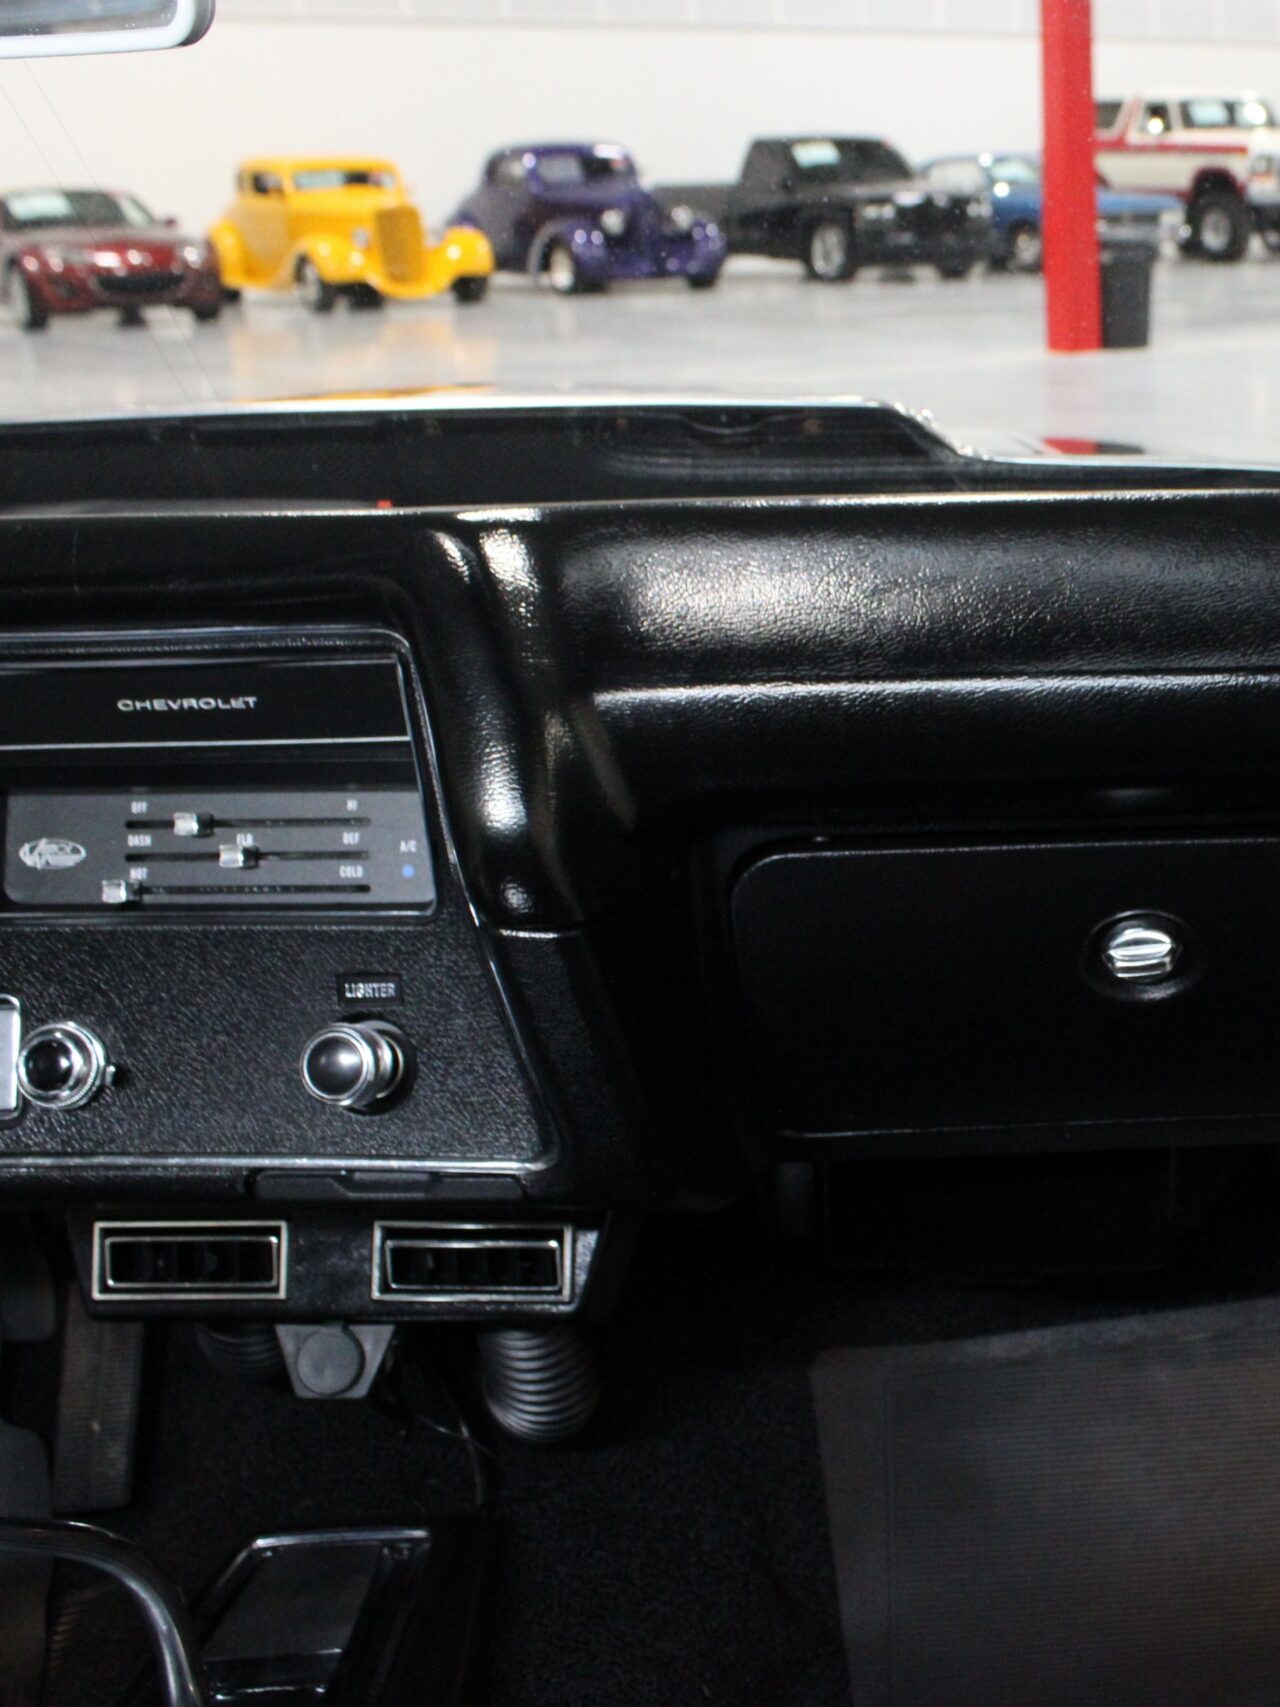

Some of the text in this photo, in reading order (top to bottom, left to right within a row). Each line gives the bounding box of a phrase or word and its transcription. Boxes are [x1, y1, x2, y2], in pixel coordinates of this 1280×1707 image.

[117, 696, 257, 711] CHEVROLET
[131, 802, 148, 814] OFF
[128, 834, 152, 847] DASH
[343, 832, 359, 845] DEF
[399, 841, 417, 853] A/C
[339, 866, 363, 878] COLD
[344, 982, 396, 998] LIGHTER
